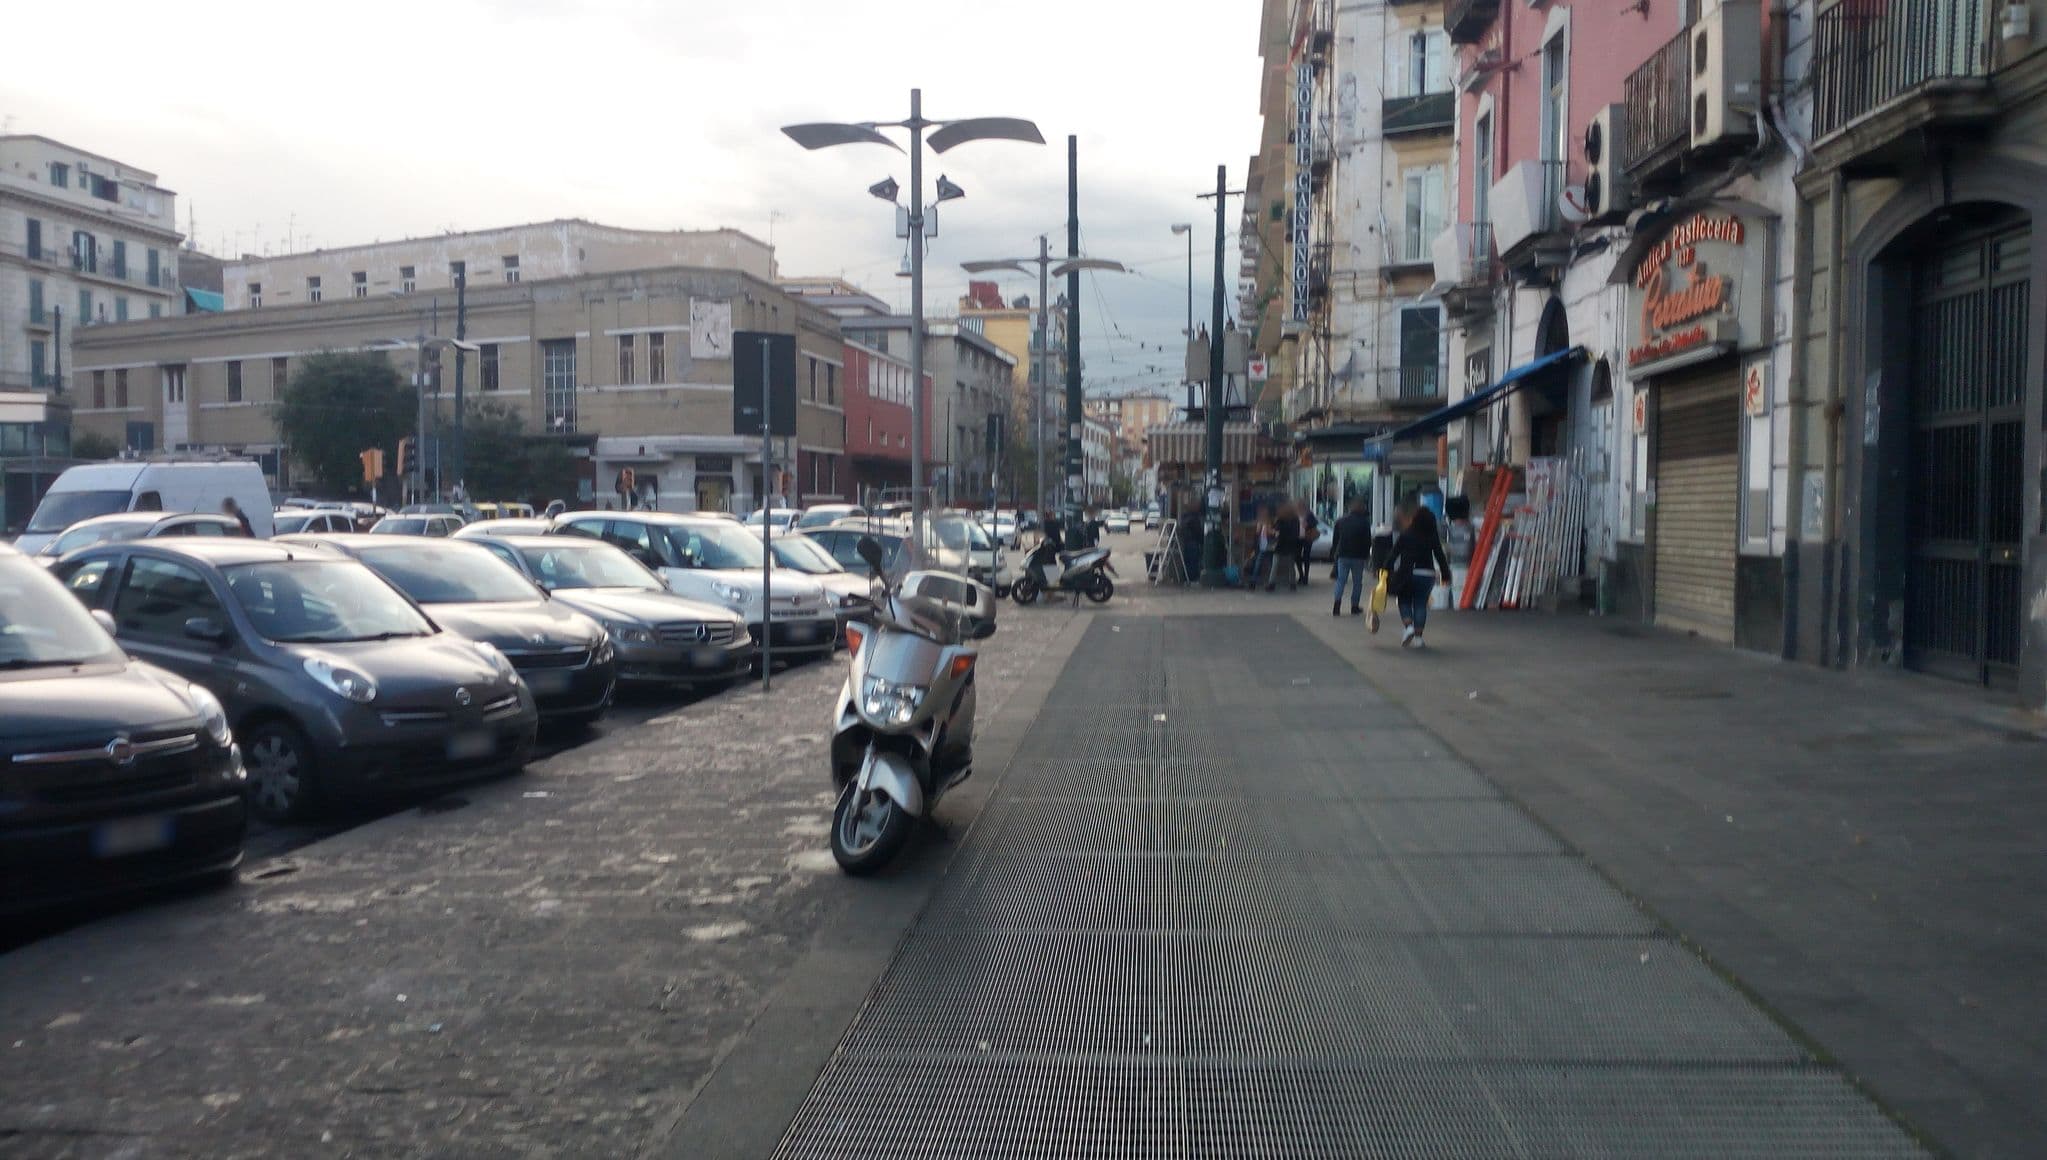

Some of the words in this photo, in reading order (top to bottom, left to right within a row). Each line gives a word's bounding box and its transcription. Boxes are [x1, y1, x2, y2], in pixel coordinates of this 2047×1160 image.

[1298, 66, 1311, 166] HOTEL
[1295, 174, 1310, 319] CASANOVA
[1636, 240, 1670, 289] Antica
[1672, 213, 1742, 250] Pasticceria
